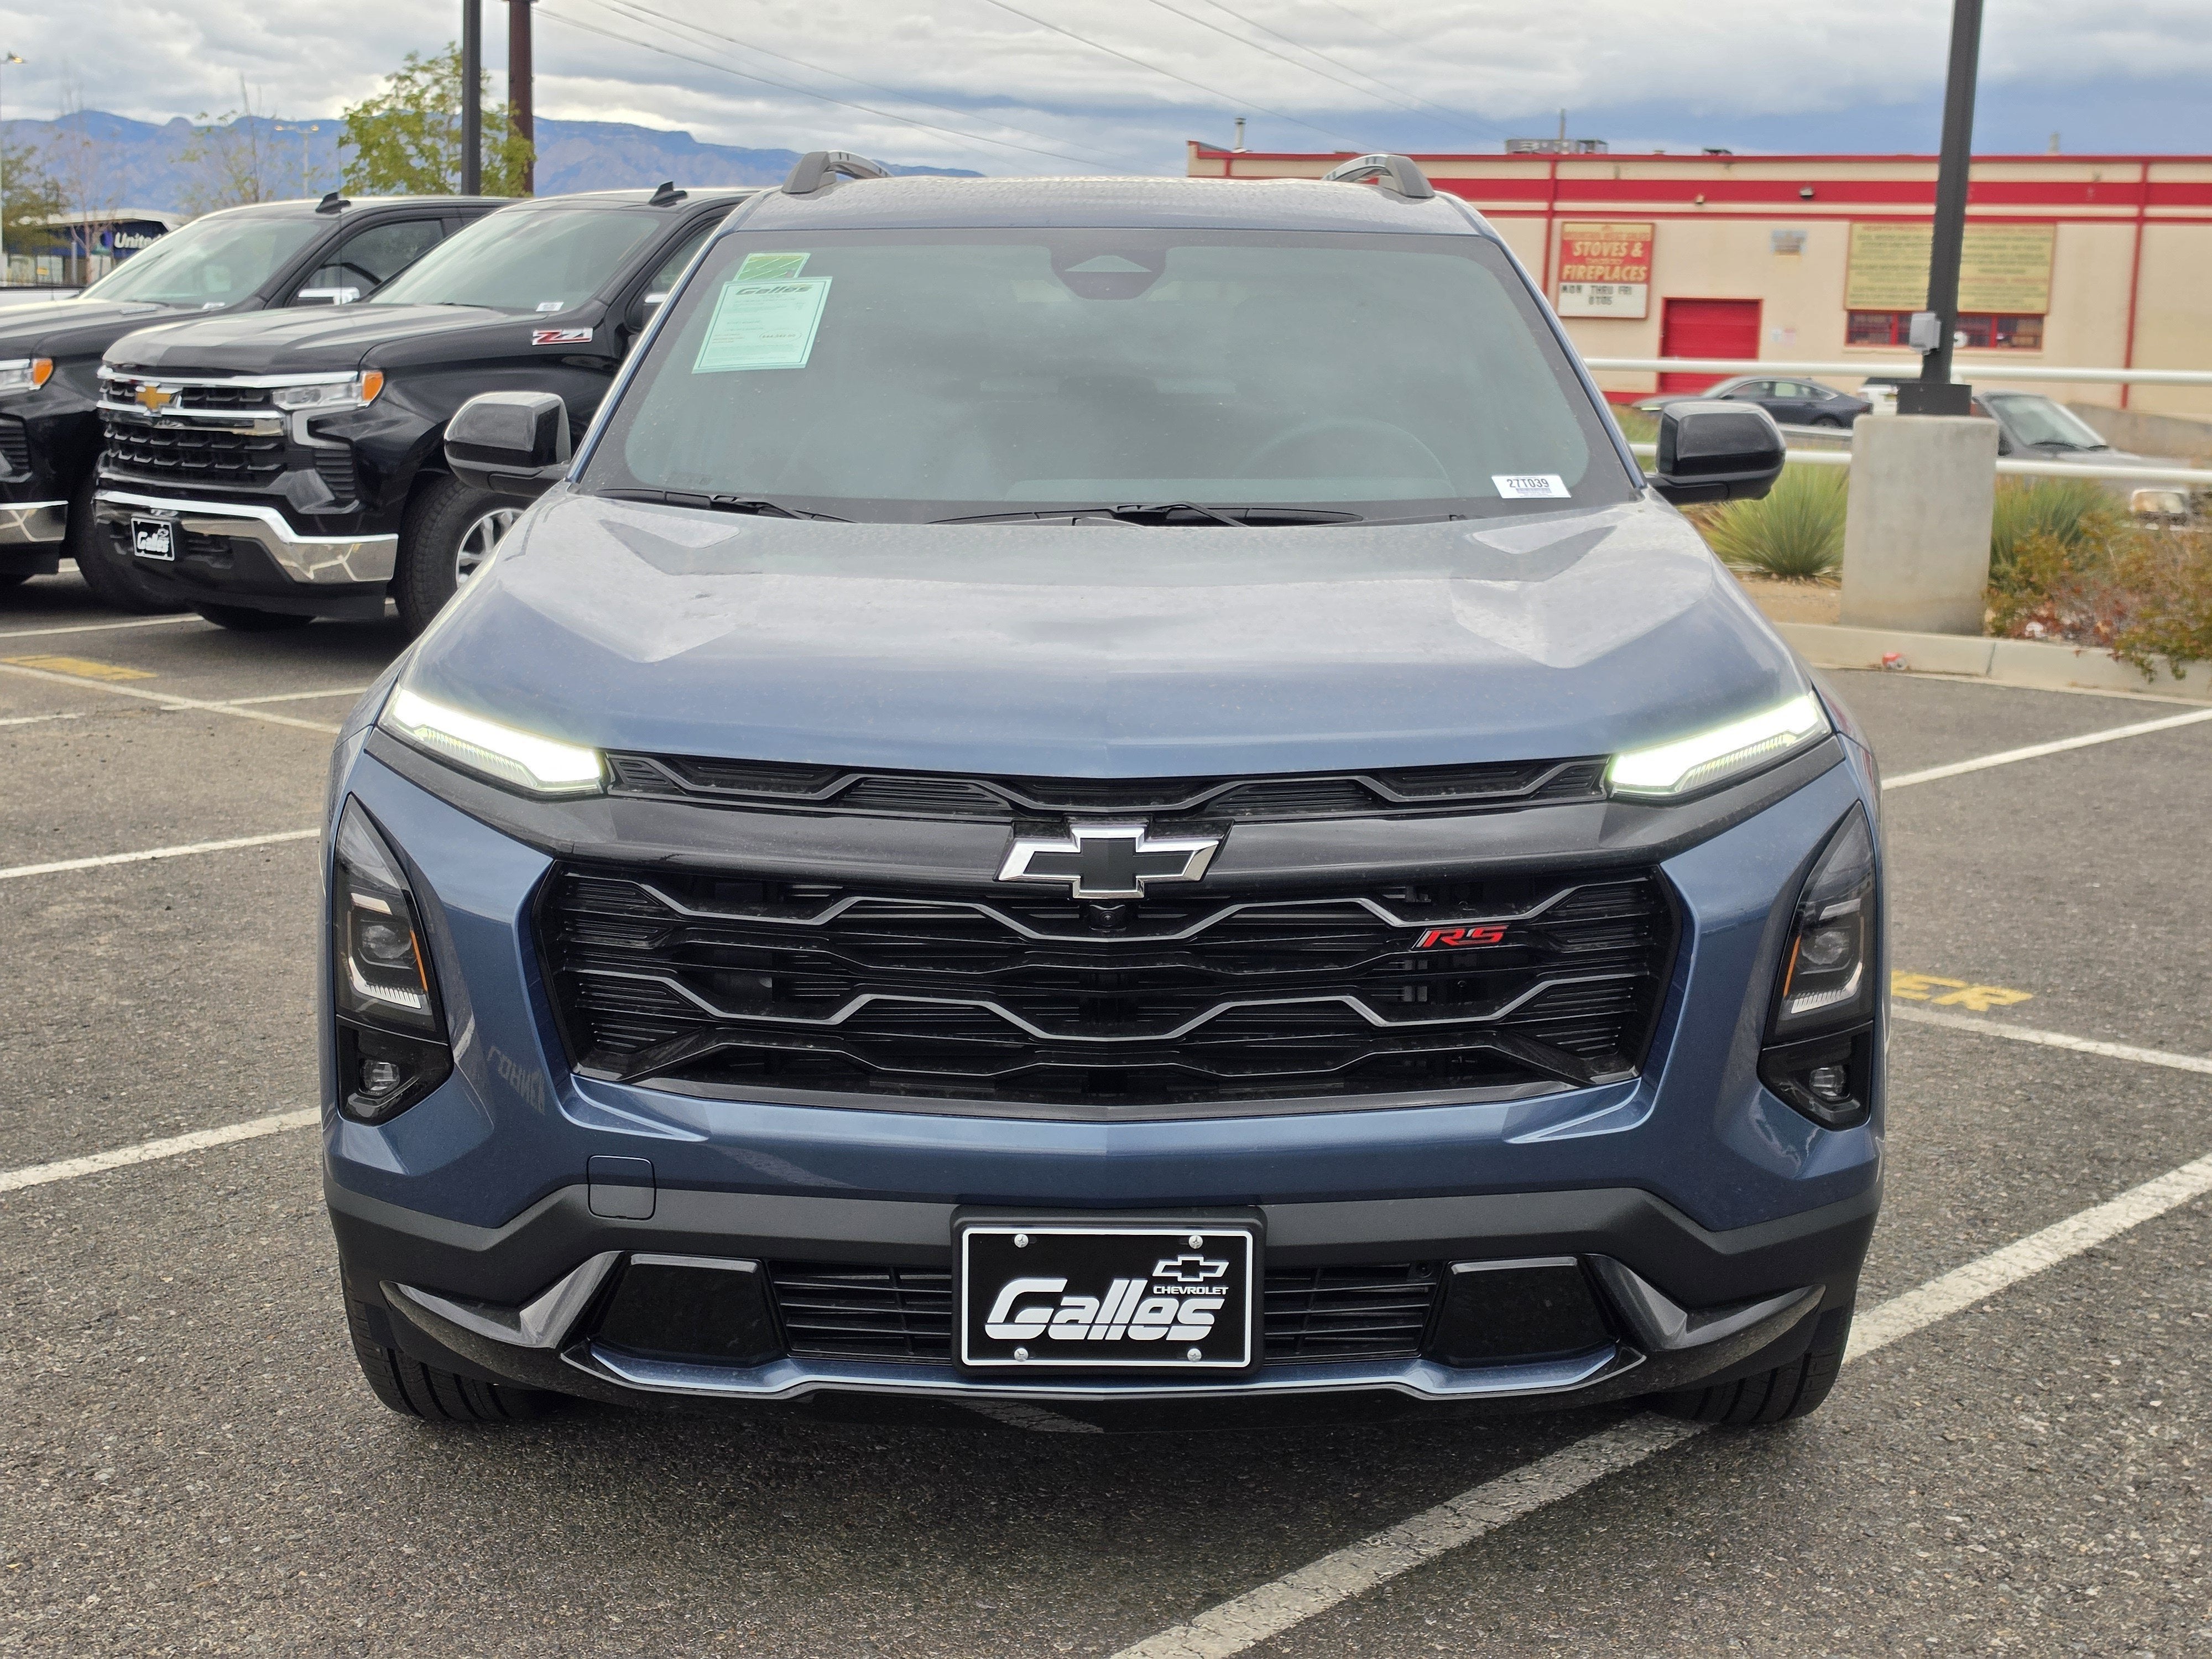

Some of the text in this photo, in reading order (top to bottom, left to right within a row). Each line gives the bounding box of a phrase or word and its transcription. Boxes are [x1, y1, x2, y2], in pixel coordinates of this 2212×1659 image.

[1572, 241, 1644, 257] STOVES &
[1562, 264, 1647, 281] FIREPLACES
[532, 328, 593, 346] Z71
[1506, 478, 1550, 488] 27T039
[1412, 924, 1510, 948] RS
[1152, 1285, 1229, 1295] CHEVROLET
[984, 1278, 1225, 1341] Galles
